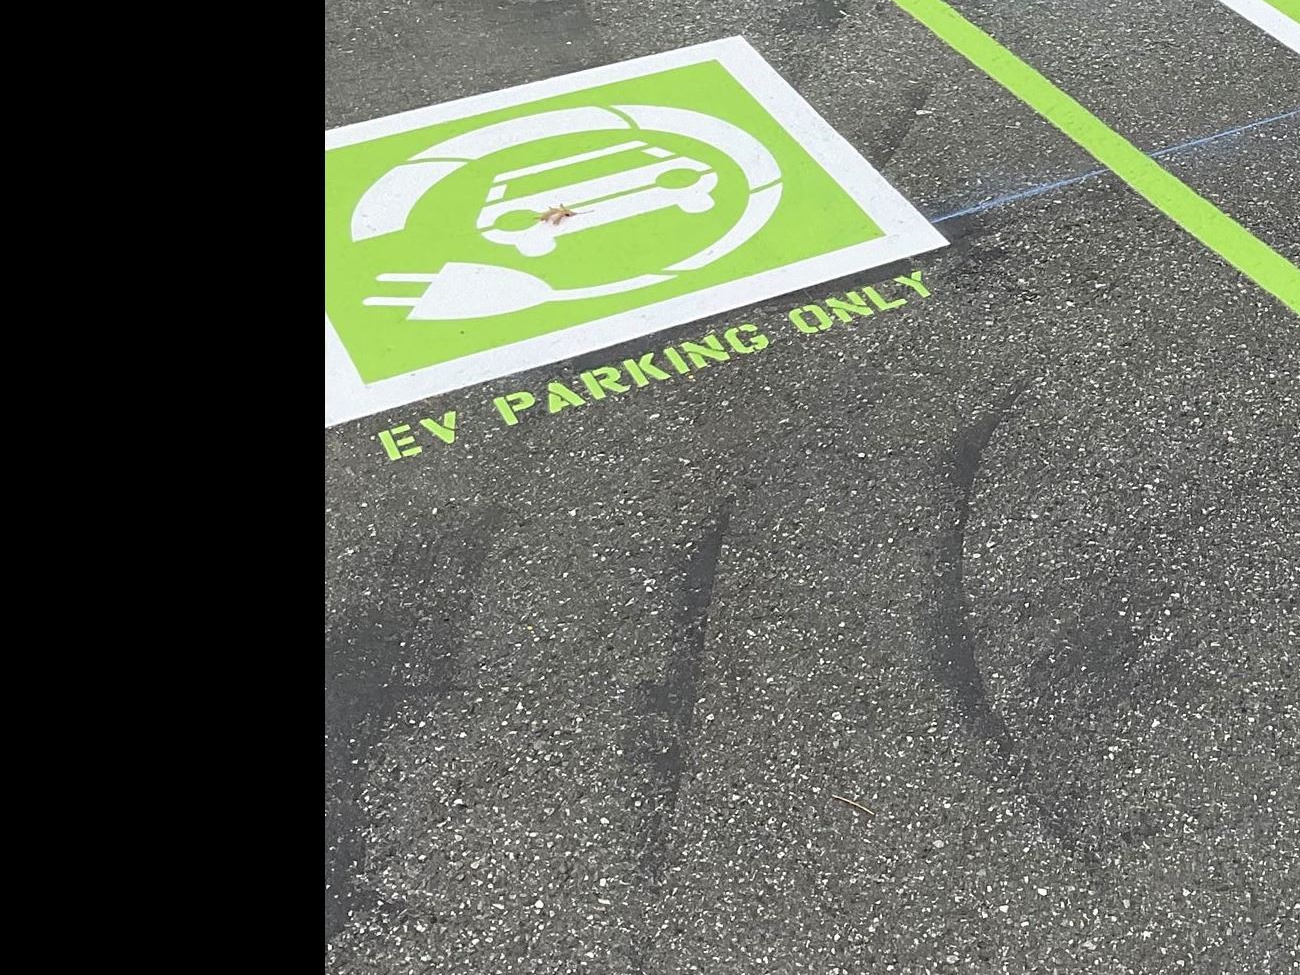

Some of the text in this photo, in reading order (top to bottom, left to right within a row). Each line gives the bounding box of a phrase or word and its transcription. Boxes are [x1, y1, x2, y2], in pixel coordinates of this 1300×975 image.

[377, 270, 932, 461] EV PARKING ONLY
